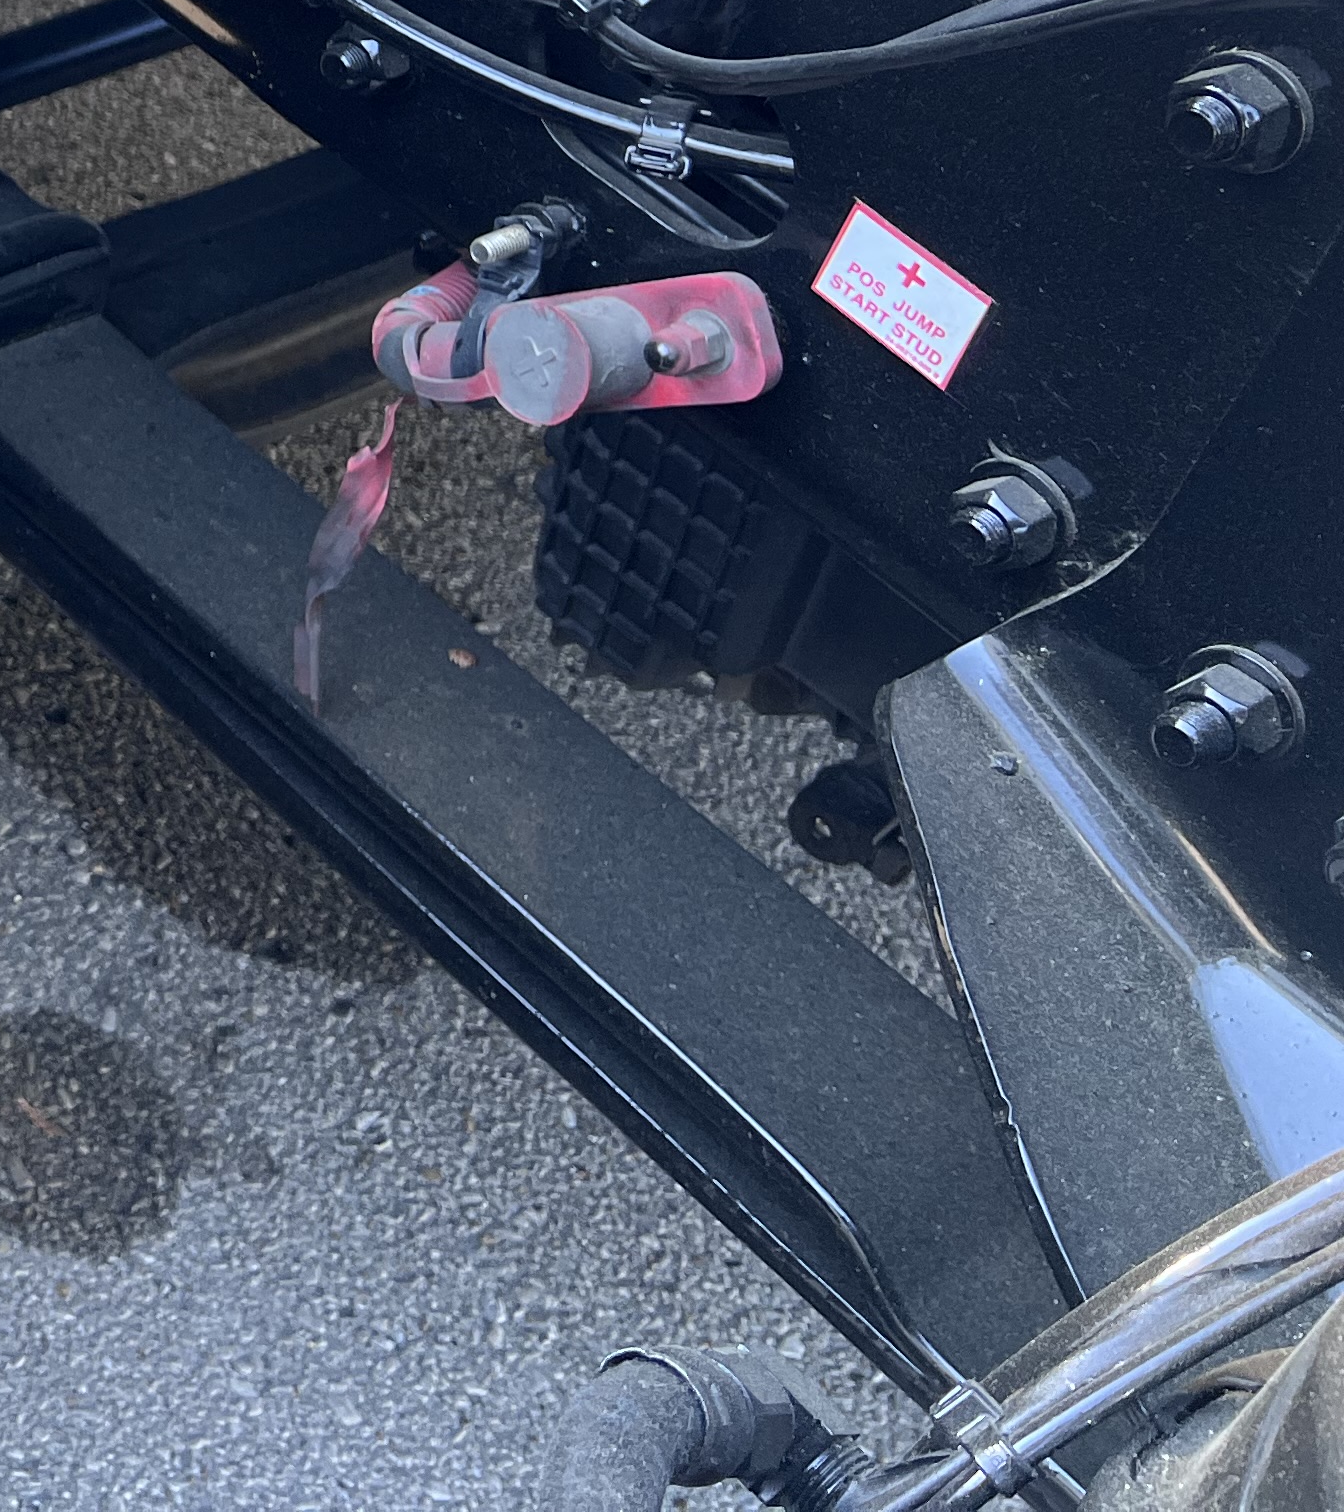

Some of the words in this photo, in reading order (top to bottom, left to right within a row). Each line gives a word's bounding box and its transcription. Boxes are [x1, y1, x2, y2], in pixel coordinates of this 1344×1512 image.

[830, 274, 891, 325] START
[891, 322, 943, 366] STUD
[847, 261, 886, 297] POS
[892, 300, 946, 339] JUMP
